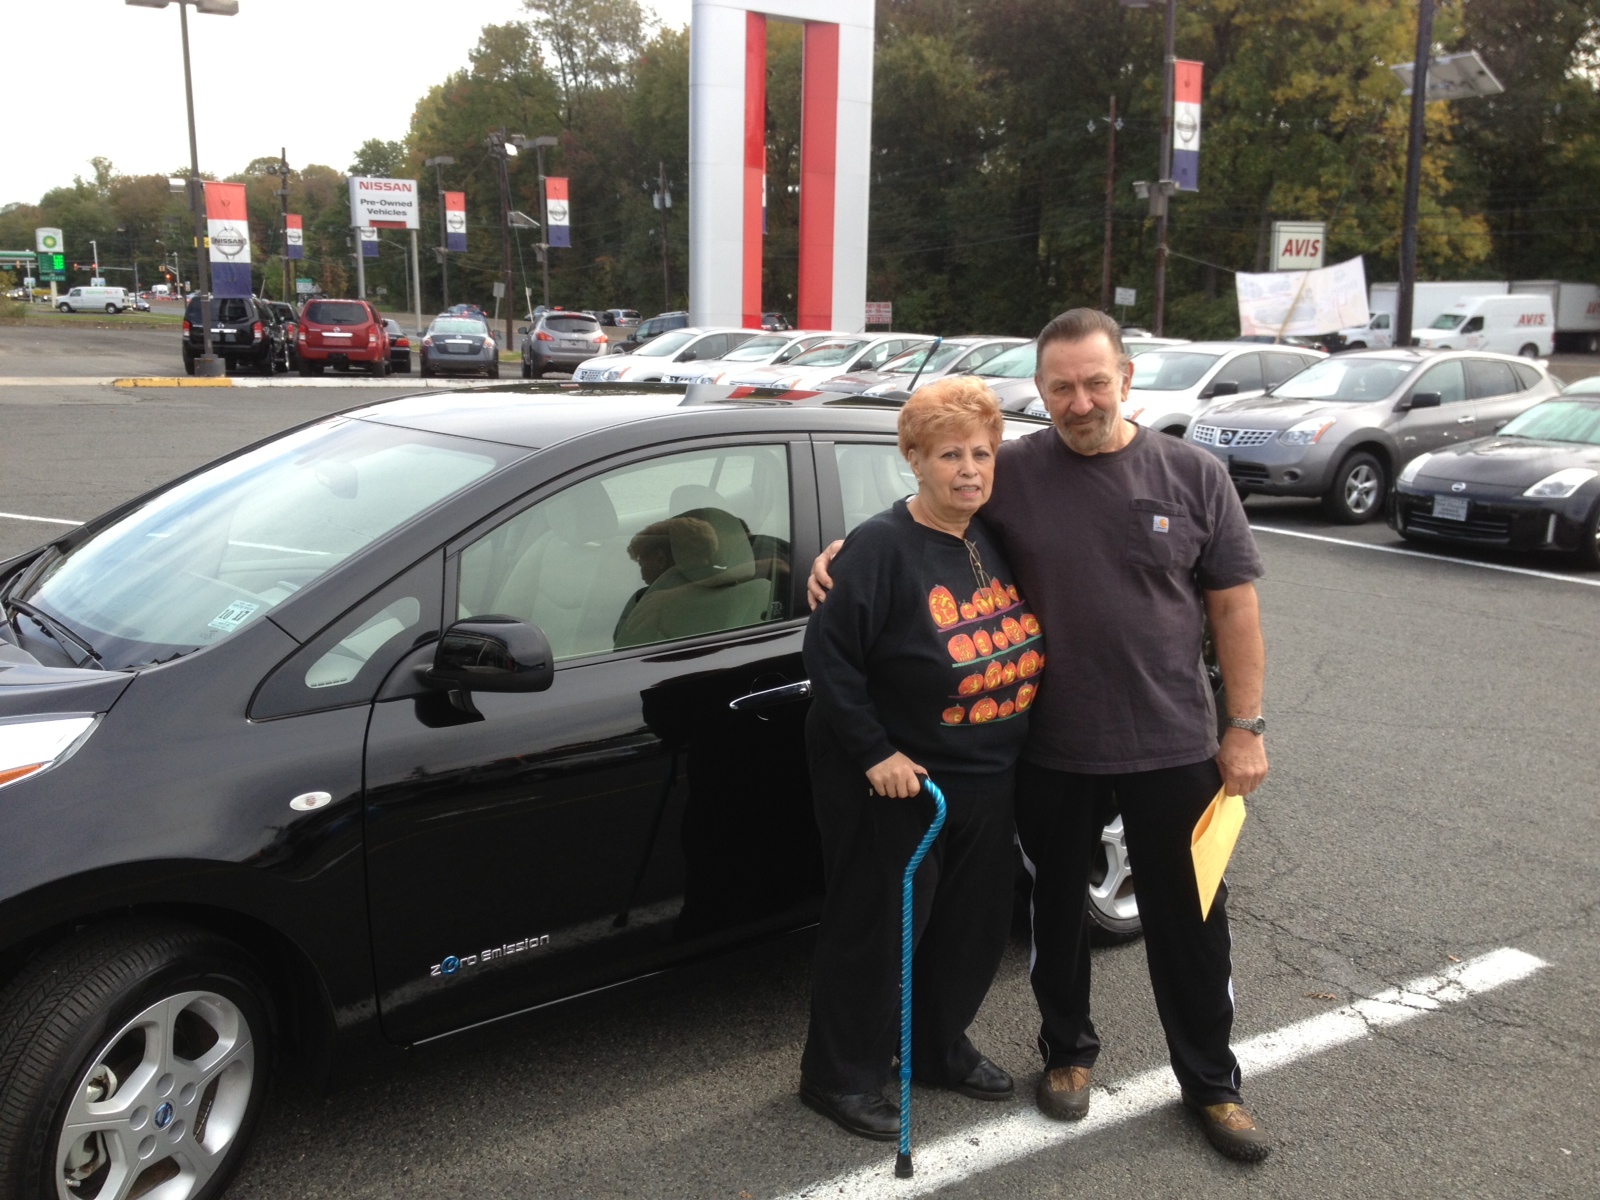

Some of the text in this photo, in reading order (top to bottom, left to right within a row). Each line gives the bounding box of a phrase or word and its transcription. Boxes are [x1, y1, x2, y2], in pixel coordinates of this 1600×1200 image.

[359, 181, 412, 192] NISSAN
[360, 199, 413, 207] Pre-Owned
[367, 208, 408, 216] Vehicles
[1282, 239, 1320, 257] AVIS
[1518, 313, 1546, 326] AVIS
